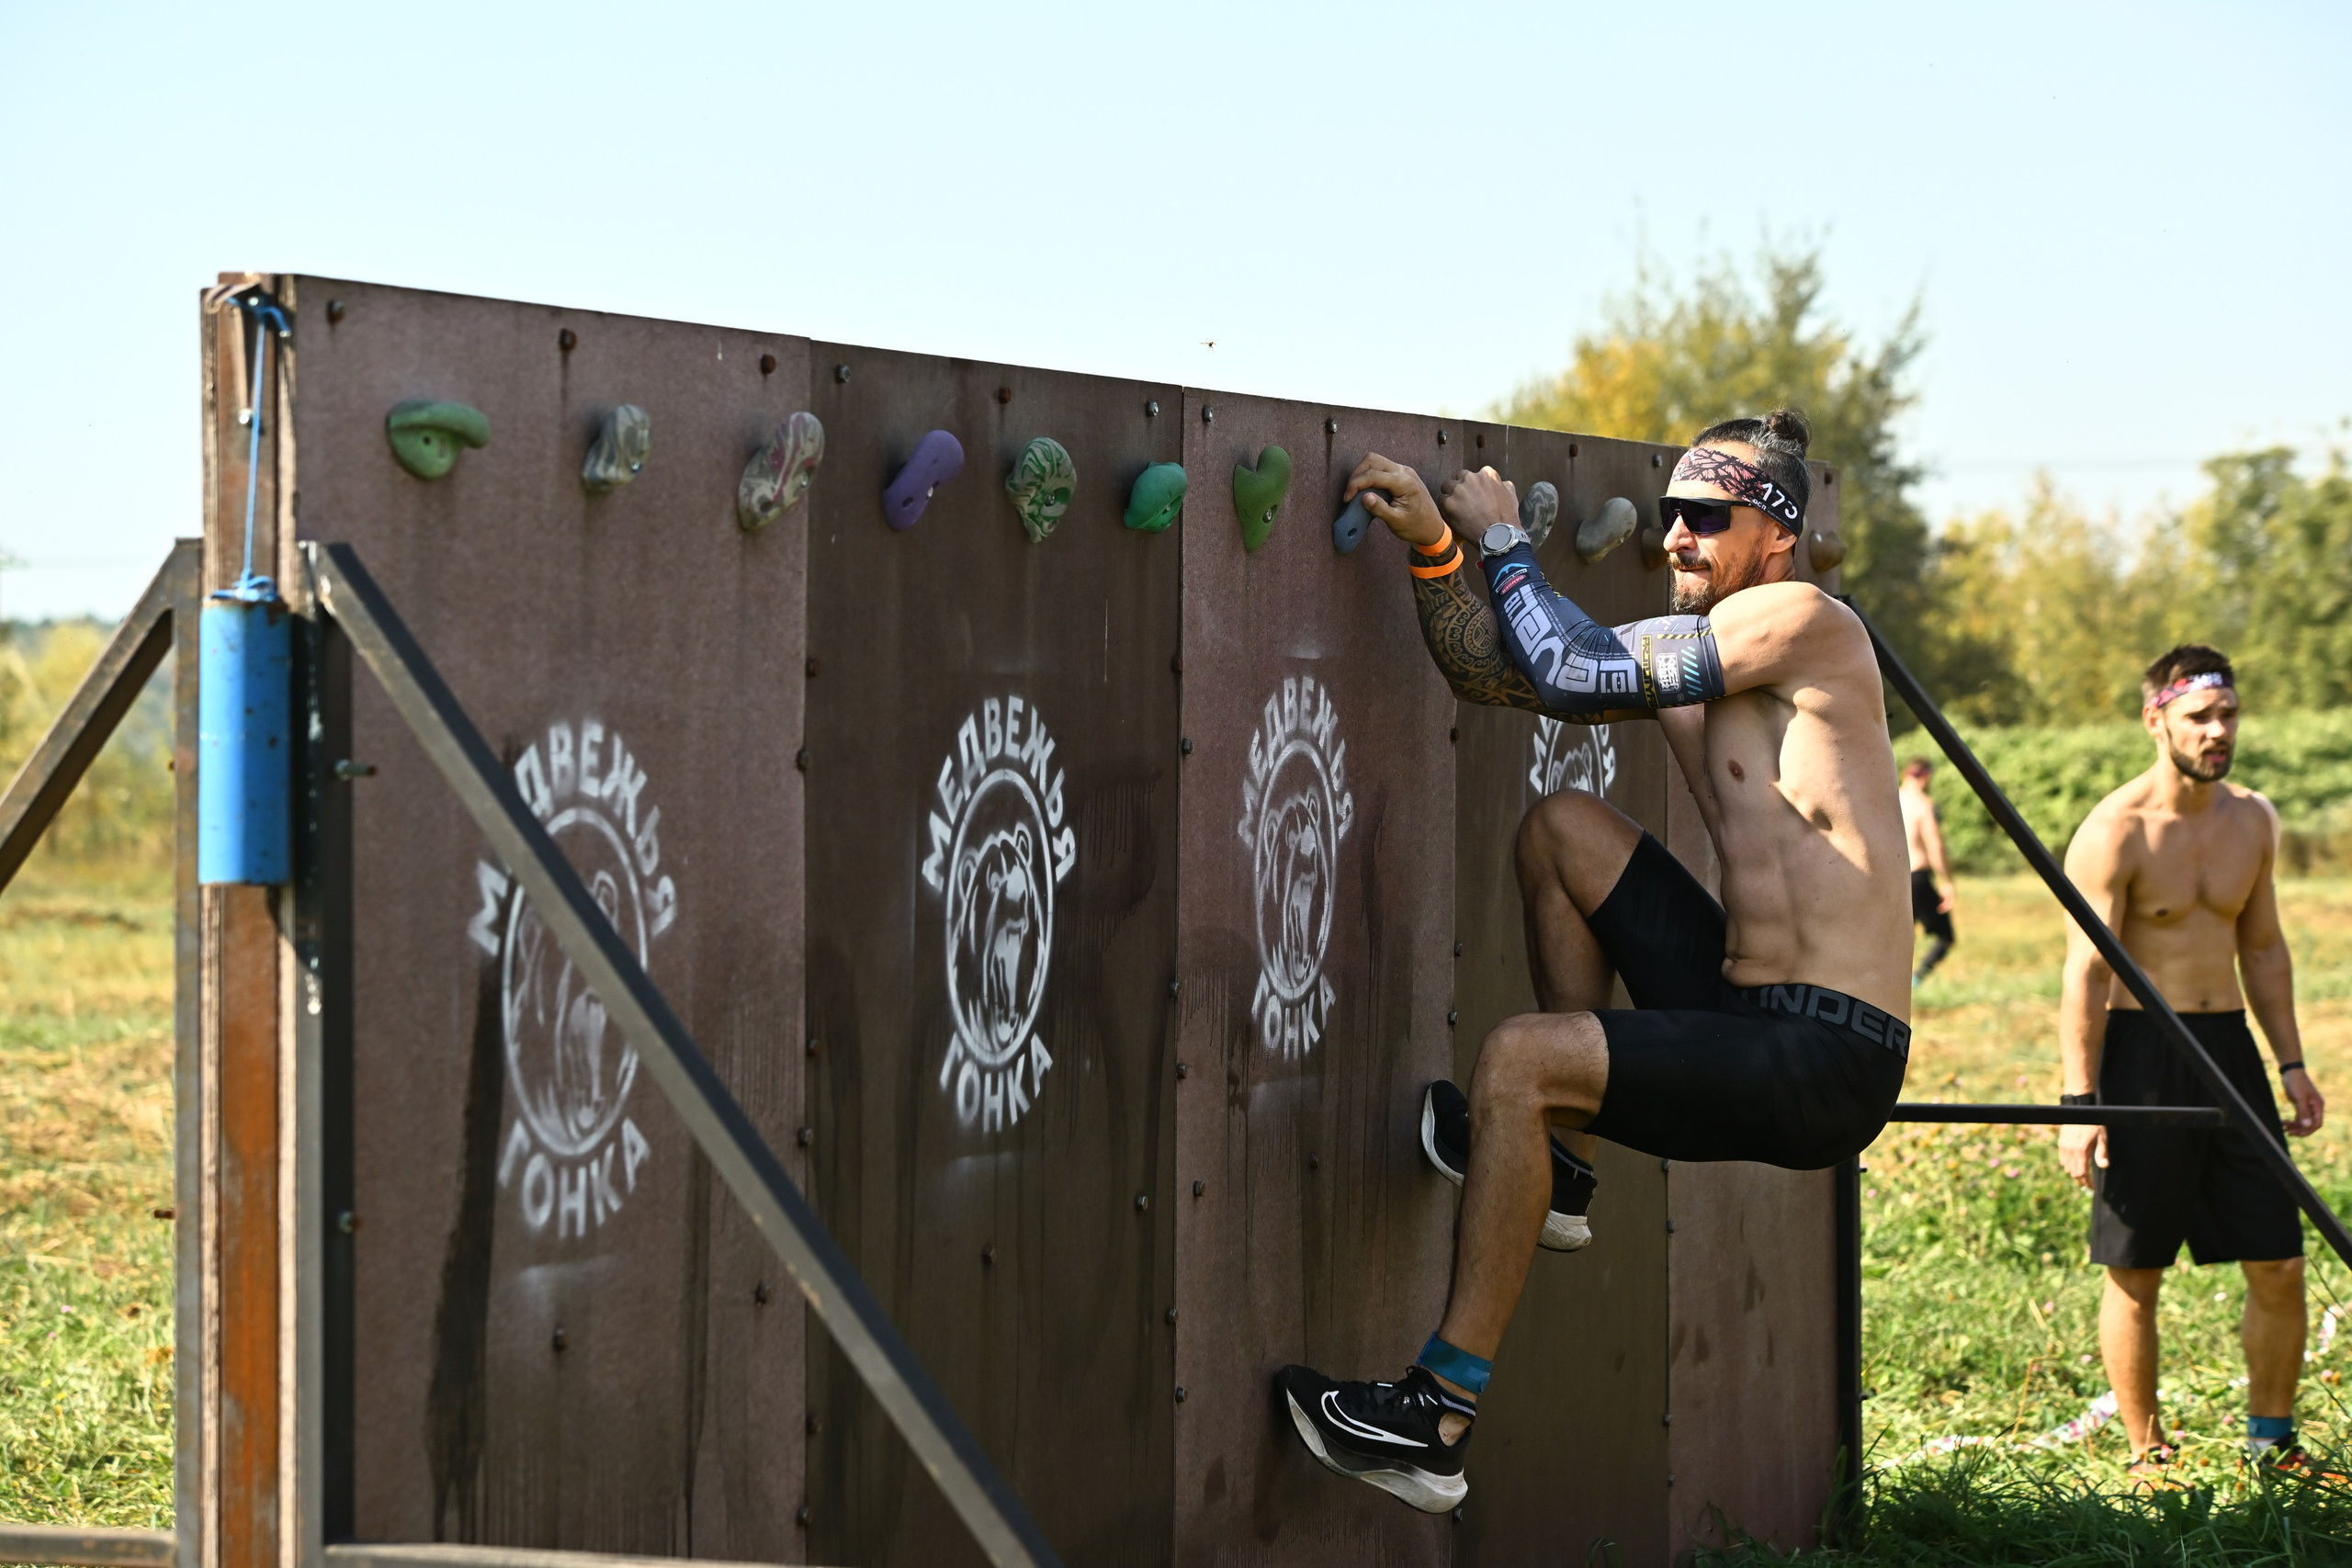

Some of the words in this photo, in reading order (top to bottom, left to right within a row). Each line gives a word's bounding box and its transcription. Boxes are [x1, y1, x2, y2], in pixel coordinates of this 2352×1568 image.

[922, 695, 1076, 893] МЕДВЕЖЬЯ
[1238, 675, 1354, 850] МЕДВЕЖЬЯ
[467, 718, 677, 957] МДВЕЖЬЯ
[938, 1031, 1054, 1134] ГОНКА
[1250, 967, 1337, 1062] ГОНКА
[497, 1116, 651, 1238] ГОНКА
